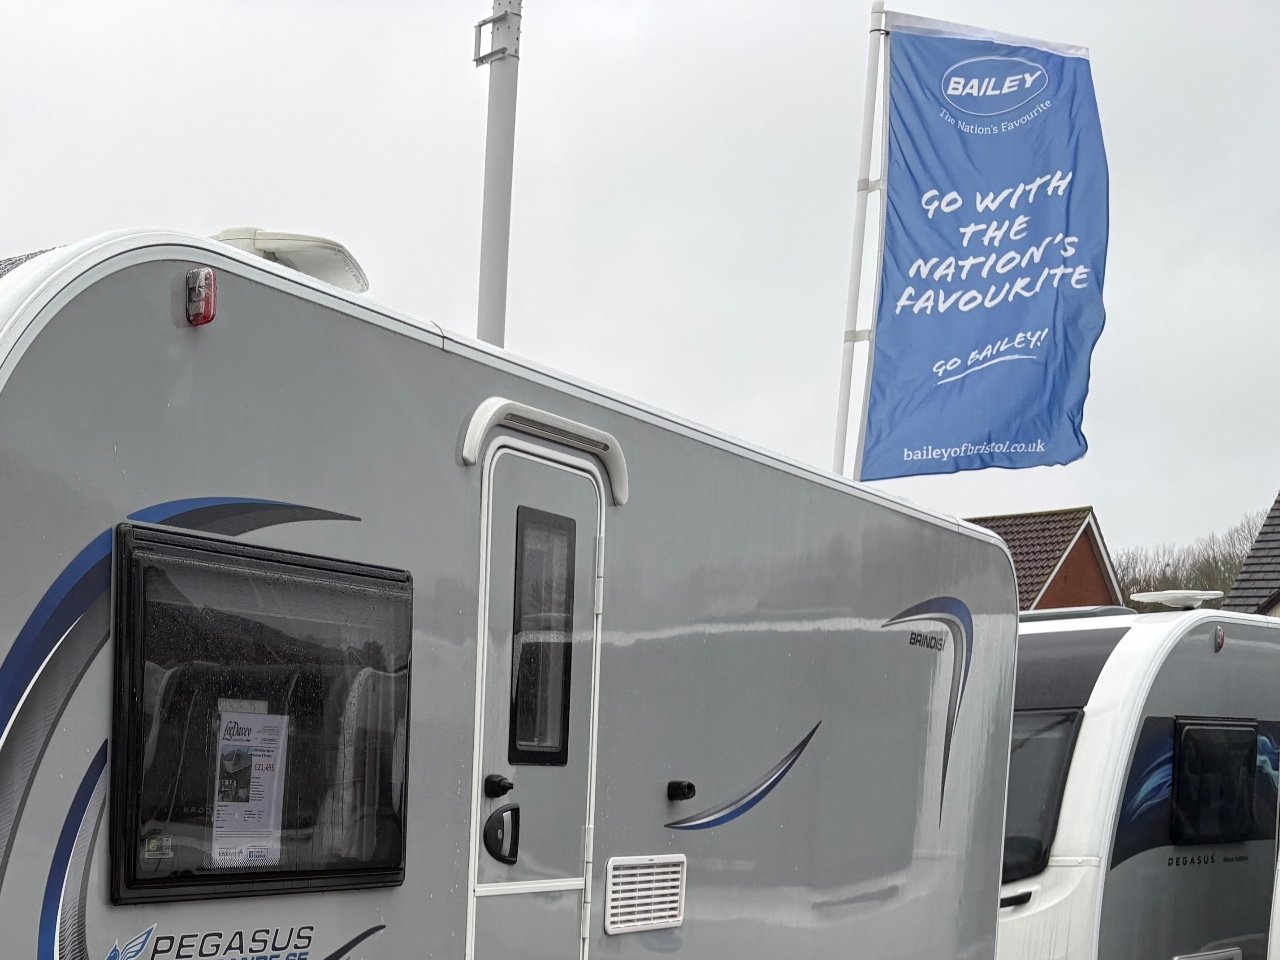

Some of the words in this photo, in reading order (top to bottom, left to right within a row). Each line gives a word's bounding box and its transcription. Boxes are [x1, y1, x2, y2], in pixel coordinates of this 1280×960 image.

[946, 70, 1042, 96] BAILEY
[939, 107, 956, 125] The
[957, 120, 999, 135] Nation's
[1001, 99, 1052, 132] Favourite
[921, 189, 963, 219] GO
[975, 170, 1072, 213] WITH
[959, 214, 1031, 247] THE
[908, 232, 1079, 283] NATION'S
[895, 264, 1091, 315] FAVOURITE
[932, 356, 962, 377] GO
[966, 327, 1049, 366] BAILEY!
[903, 438, 1046, 461] baileyofbristol.co.uk
[909, 631, 946, 652] BRINDISI
[1167, 854, 1216, 867] PEGASUS
